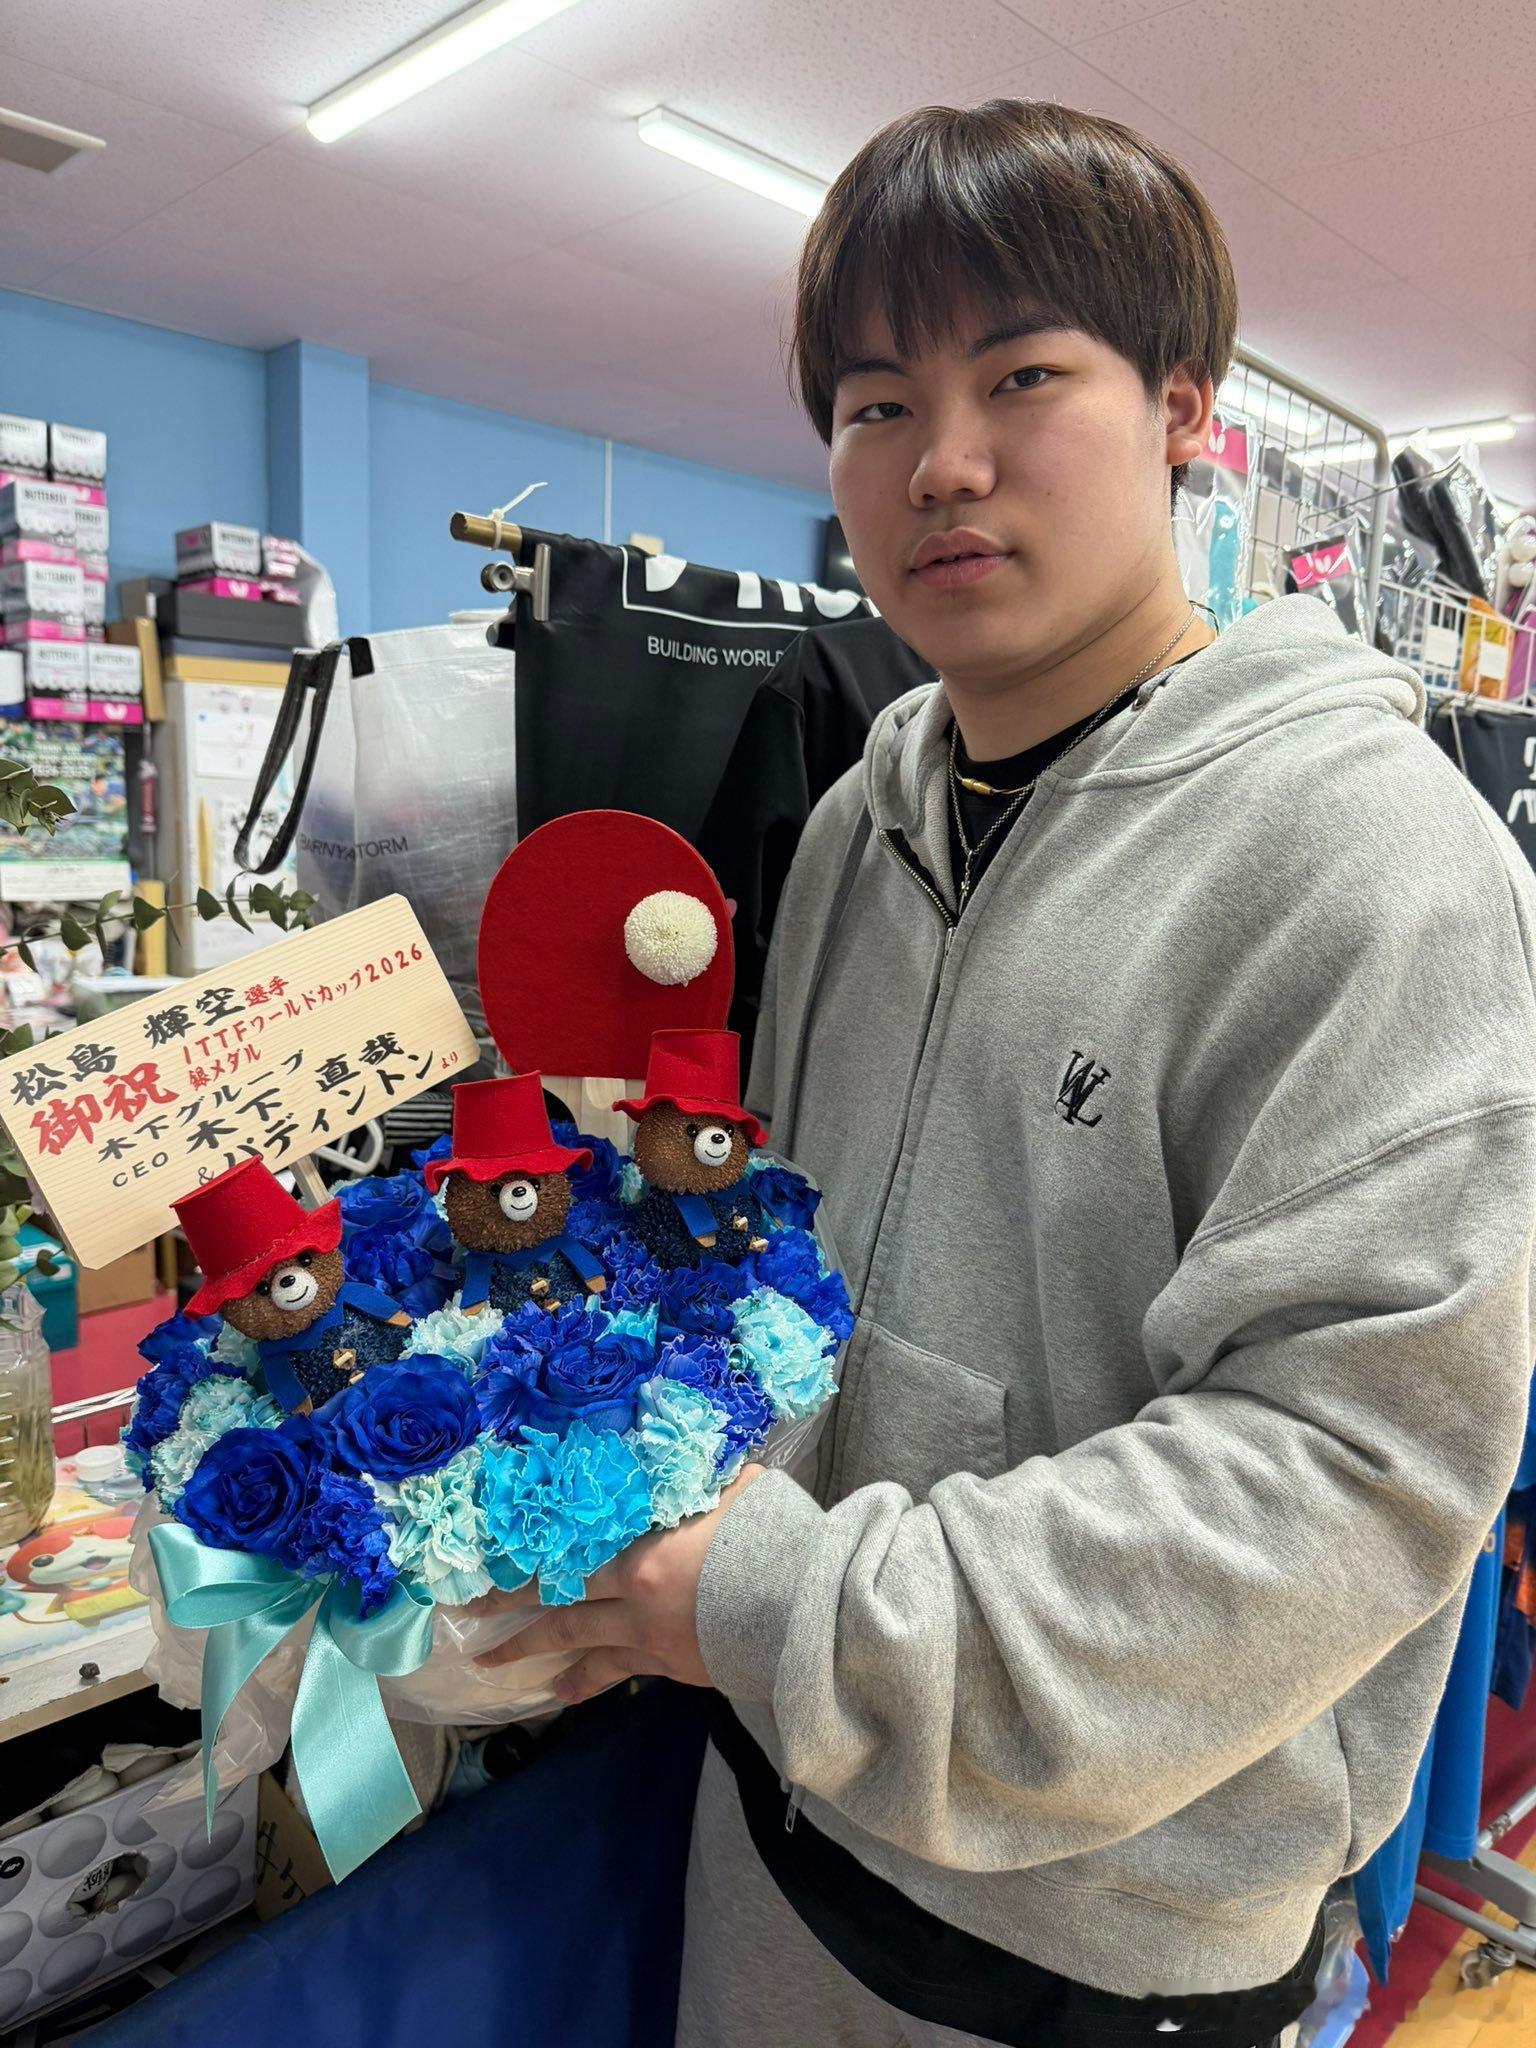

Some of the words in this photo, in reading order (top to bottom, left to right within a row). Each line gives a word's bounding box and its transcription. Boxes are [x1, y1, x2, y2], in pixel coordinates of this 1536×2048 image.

[647, 635, 718, 666] BUILDING
[11, 1043, 118, 1106] 松島
[143, 987, 246, 1049] 輝空
[244, 975, 289, 1007] 選手
[189, 1043, 262, 1091] 銀メダル
[30, 1062, 180, 1156] 御祝
[98, 1049, 304, 1164] 木下グループ
[186, 1087, 283, 1154] 木下
[314, 1031, 404, 1093] 直哉
[112, 1151, 169, 1188] CEO
[198, 1166, 214, 1186] &
